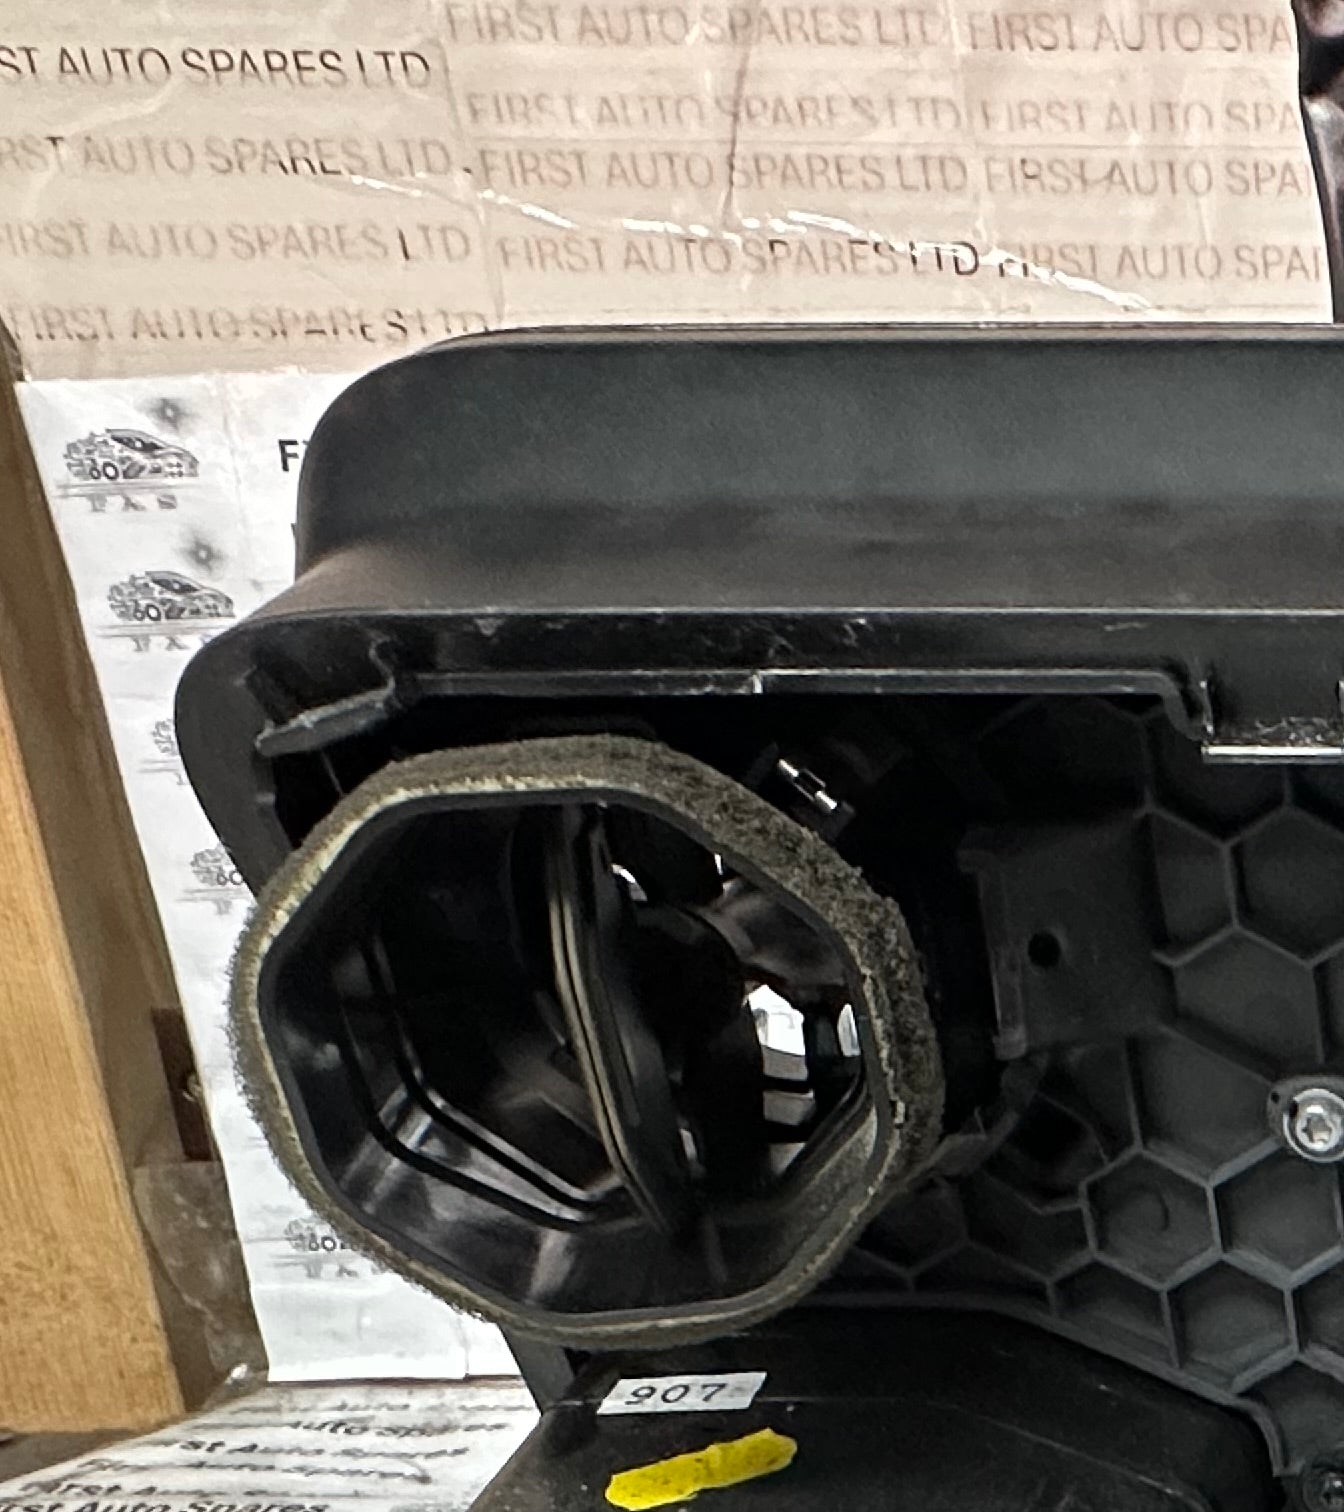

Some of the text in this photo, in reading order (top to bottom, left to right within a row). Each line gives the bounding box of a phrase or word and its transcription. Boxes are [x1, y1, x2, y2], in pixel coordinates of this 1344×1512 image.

[578, 6, 688, 45] AUTO
[967, 12, 1203, 52] FIRST AUTO
[59, 48, 431, 89] AUTO SPARES LTD
[83, 136, 369, 175] AUTO SPARES
[480, 148, 967, 192] FIRST AUTO SPARES LTD
[398, 227, 471, 261] LTD
[500, 238, 605, 273] FIRST
[624, 238, 733, 273] AUTO
[742, 238, 898, 274] SPARES
[625, 1383, 728, 1405] 907
